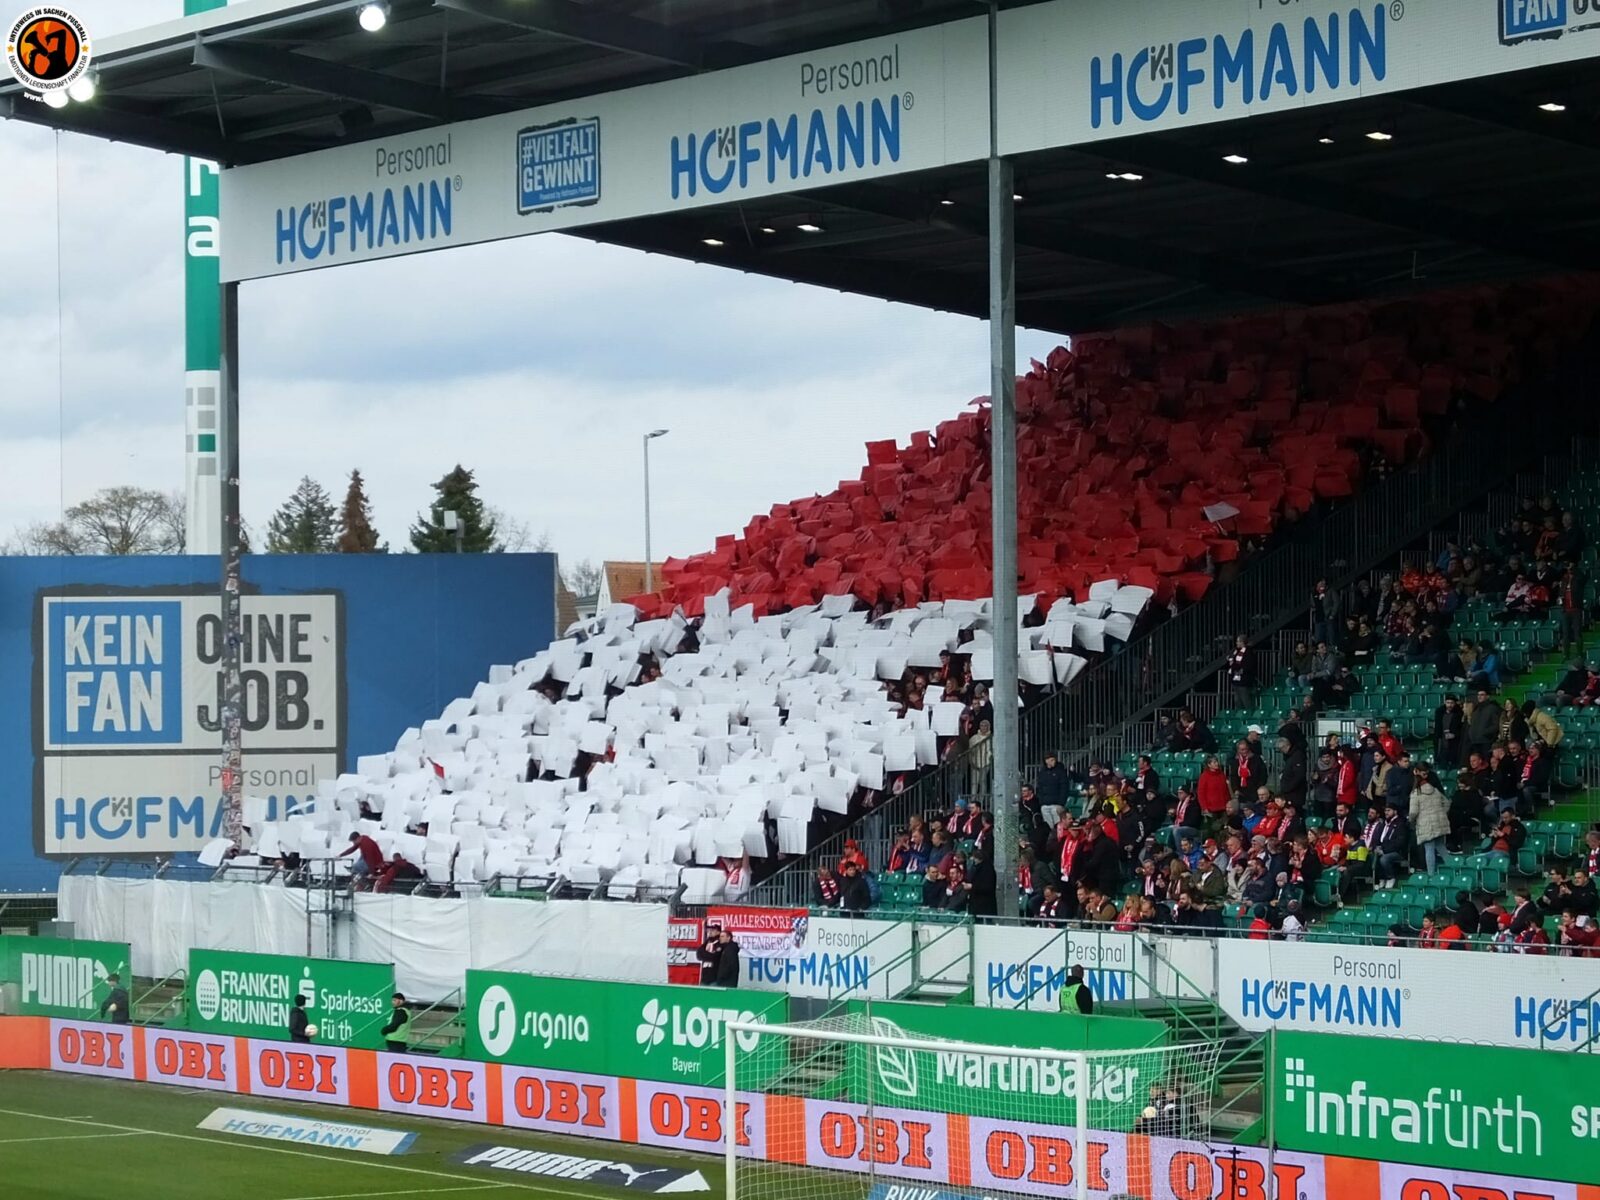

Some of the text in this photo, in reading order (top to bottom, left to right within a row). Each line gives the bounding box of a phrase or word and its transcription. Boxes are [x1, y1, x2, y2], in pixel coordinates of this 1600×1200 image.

[801, 43, 899, 97] Personal
[376, 133, 451, 177] Personal
[522, 127, 594, 165] #VIELFALT
[523, 155, 594, 193] GEWINNT
[65, 615, 162, 665] KEIN
[66, 671, 162, 732] FAN
[209, 764, 315, 787] Prsonal
[818, 928, 868, 947] Personal
[1067, 941, 1126, 963] Personal
[22, 953, 94, 1009] PUMA
[221, 970, 289, 999] FRANKEN
[987, 962, 1126, 1001] HOFMNN
[1333, 955, 1401, 979] Personal
[221, 998, 289, 1028] BRUNNEN
[320, 988, 382, 1015] Sparkasse
[58, 1028, 124, 1069] OBI
[521, 1011, 589, 1049] signia
[154, 1037, 226, 1082] OBI
[259, 1049, 337, 1094] OBI
[388, 1063, 474, 1111] OBI
[514, 1076, 605, 1128] OBI
[312, 1122, 371, 1136] Personal
[650, 1092, 750, 1146] OBI
[819, 1112, 932, 1169] OBI
[986, 1130, 1109, 1191] OBI
[463, 1146, 614, 1179] PUMA
